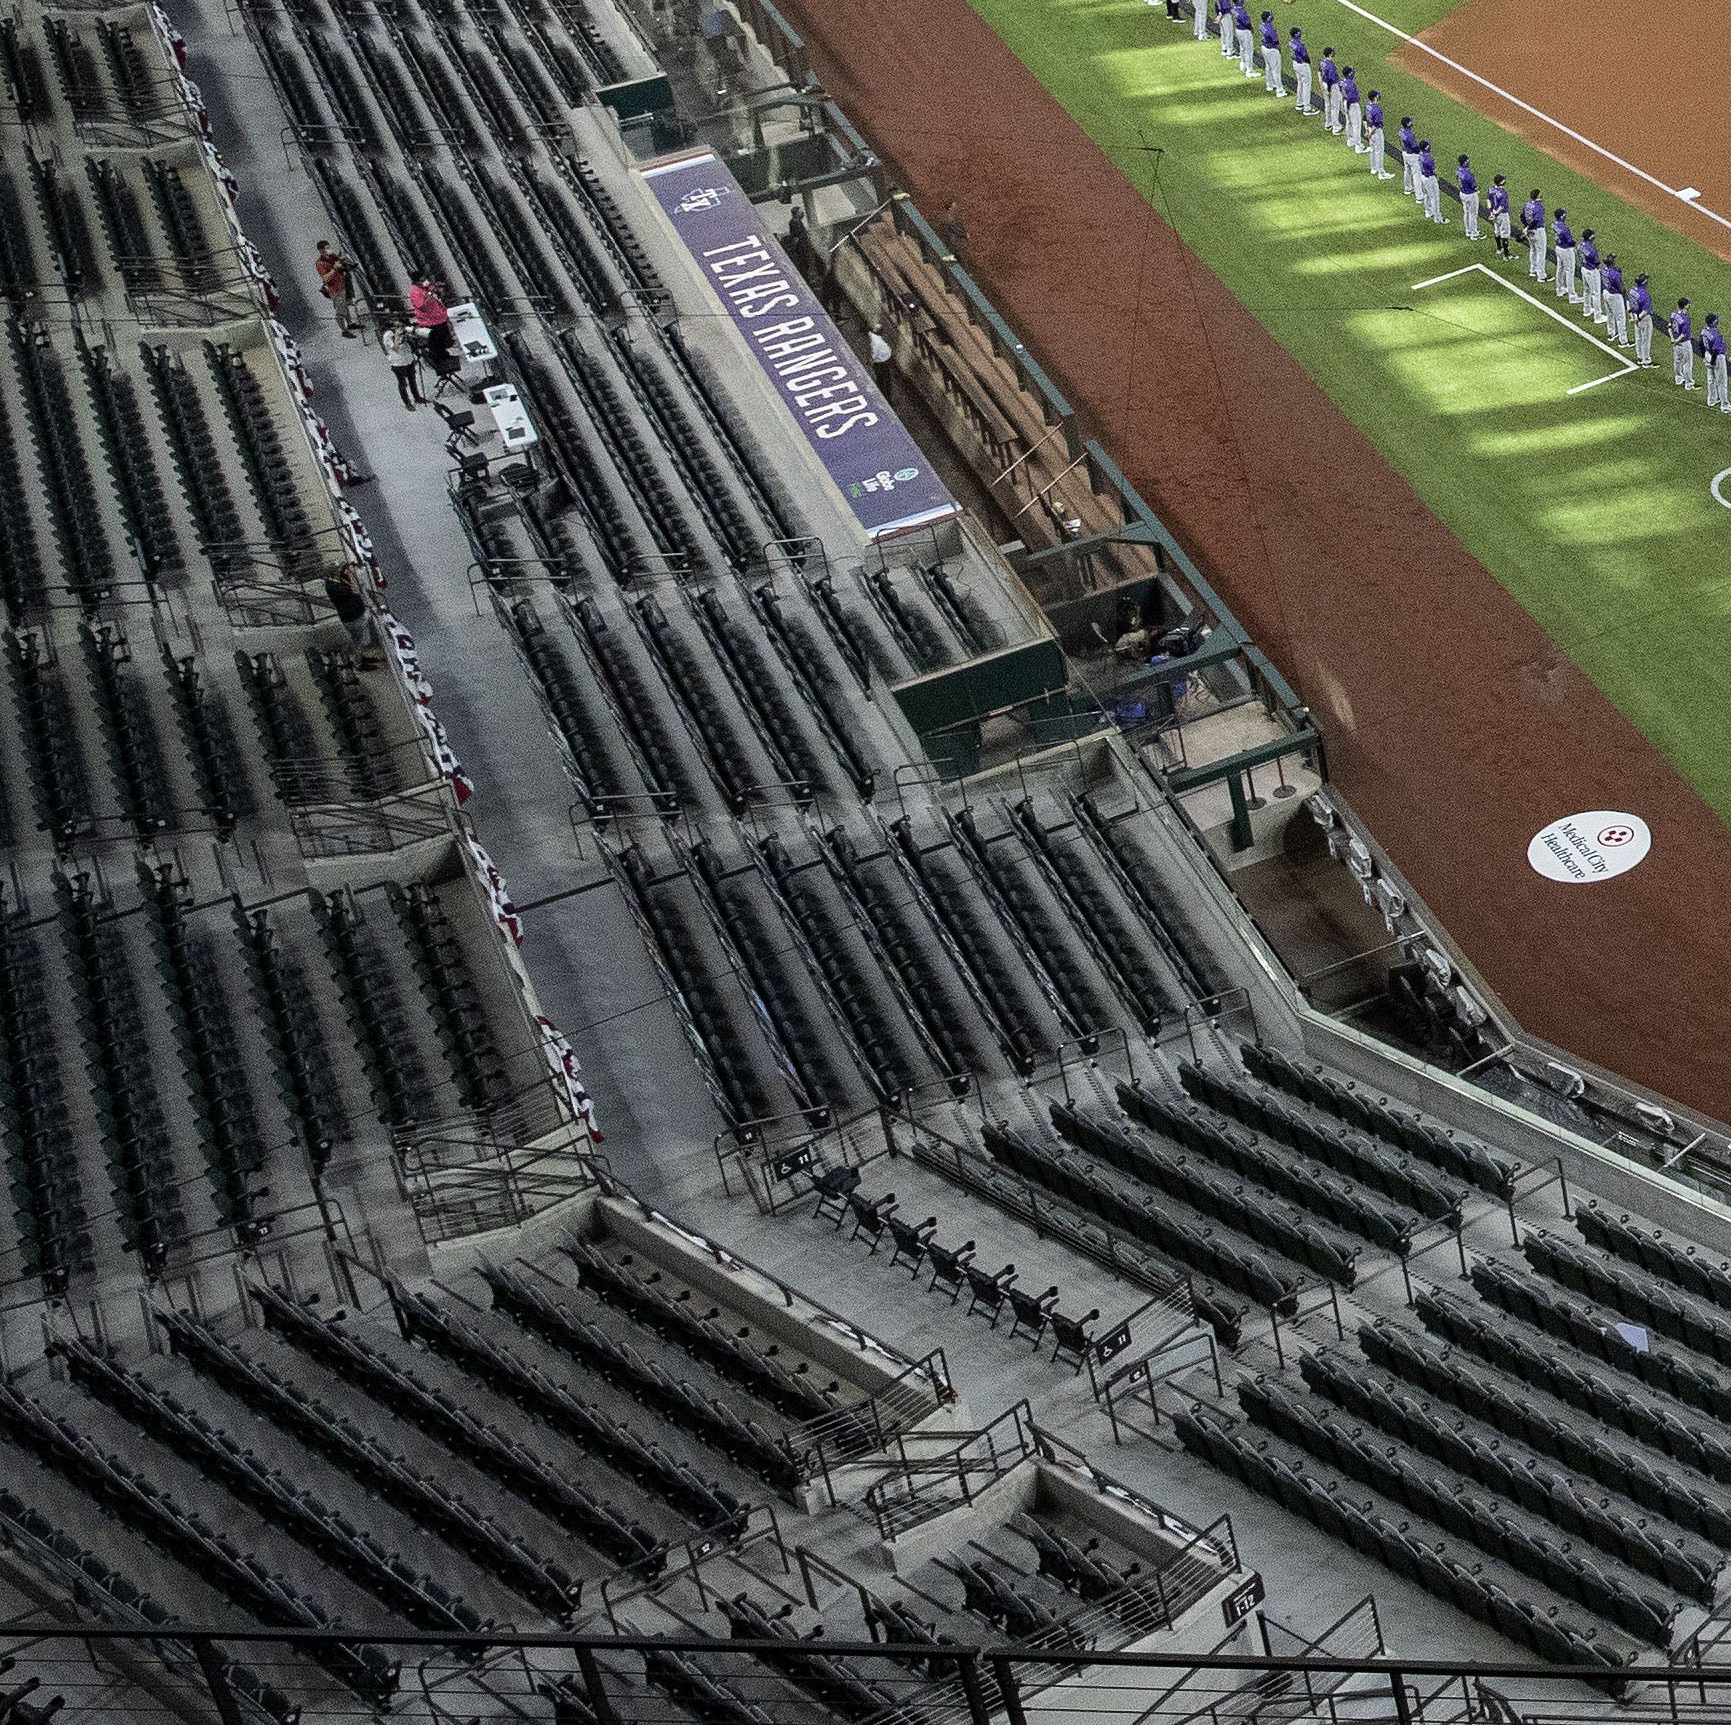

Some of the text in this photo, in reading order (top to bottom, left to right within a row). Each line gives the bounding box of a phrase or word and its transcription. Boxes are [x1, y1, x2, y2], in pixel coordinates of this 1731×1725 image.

[703, 235, 879, 440] TEXAS RANGERS
[1539, 832, 1586, 880] Healthcare
[1556, 821, 1611, 874] Medical City
